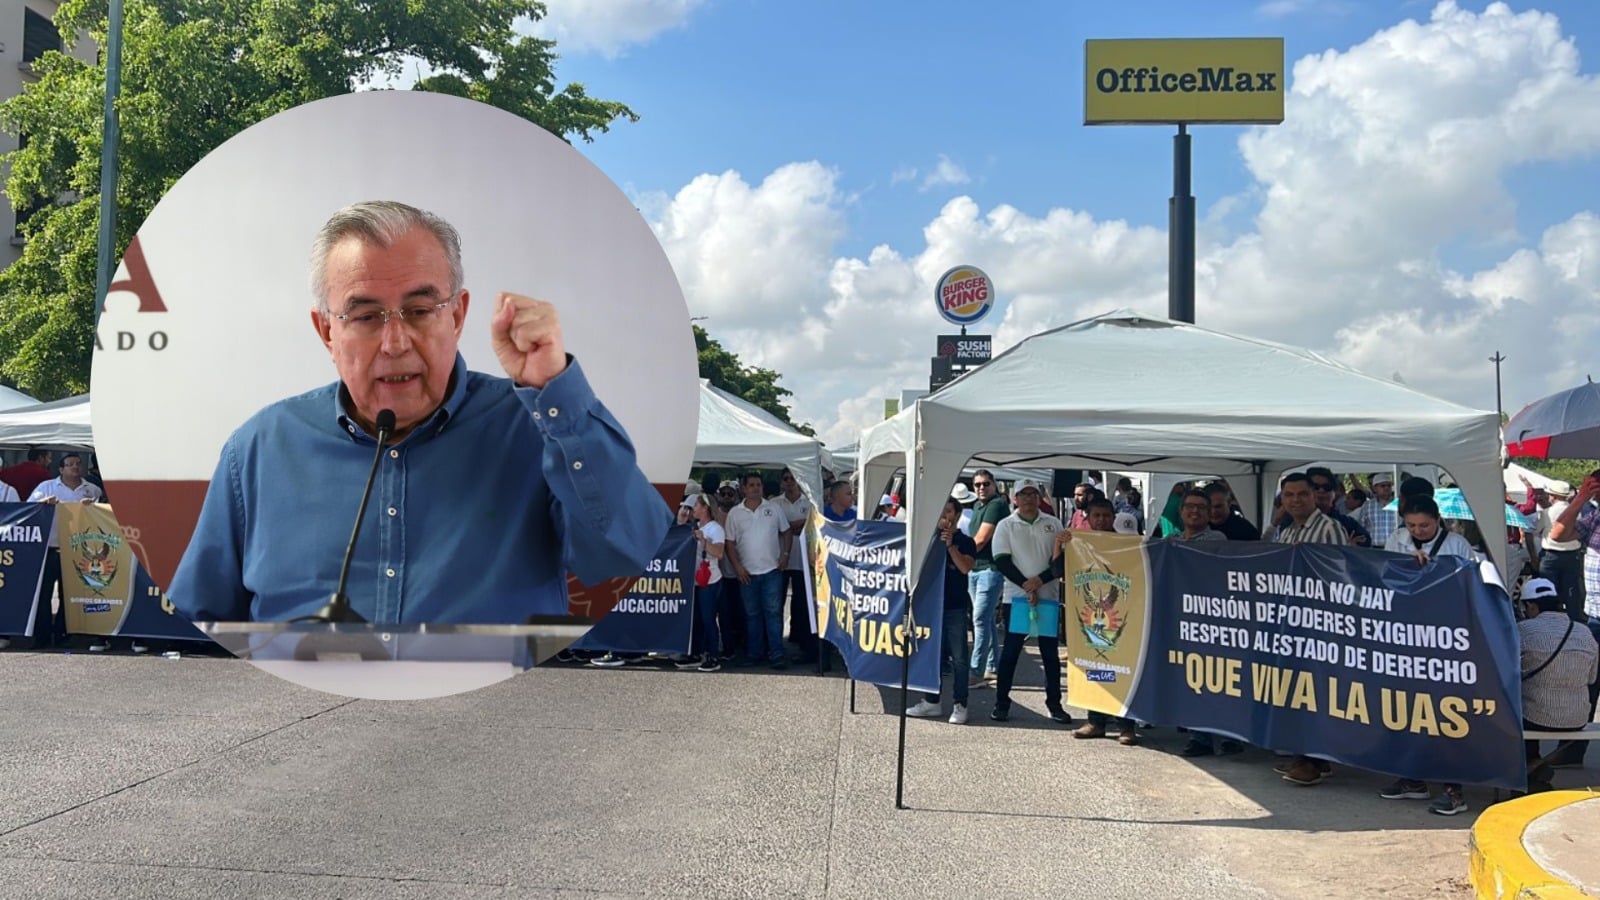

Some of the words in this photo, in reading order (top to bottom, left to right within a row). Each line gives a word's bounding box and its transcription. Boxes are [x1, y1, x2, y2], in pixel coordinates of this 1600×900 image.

[1096, 66, 1277, 94] OfficeMax
[943, 277, 987, 297] BURGER
[944, 287, 988, 312] KING
[957, 340, 991, 351] SUSHI
[664, 559, 680, 573] AL
[1227, 570, 1250, 592] EN
[1255, 573, 1325, 601] SINALOA
[1329, 582, 1355, 606] NO
[1359, 585, 1395, 612] HAY
[1182, 594, 1250, 621] DIVISIÓN
[1255, 602, 1275, 624] DE
[1277, 604, 1356, 637] PODERES
[1361, 617, 1470, 651] EXIGIMOS
[1179, 620, 1250, 649] RESPETO
[1253, 631, 1270, 653] AL
[1272, 634, 1339, 665] ESTADO
[1344, 645, 1367, 671] DE
[1372, 650, 1477, 685] DERECHO
[1251, 662, 1318, 713] VIVA
[1328, 676, 1371, 725] LA
